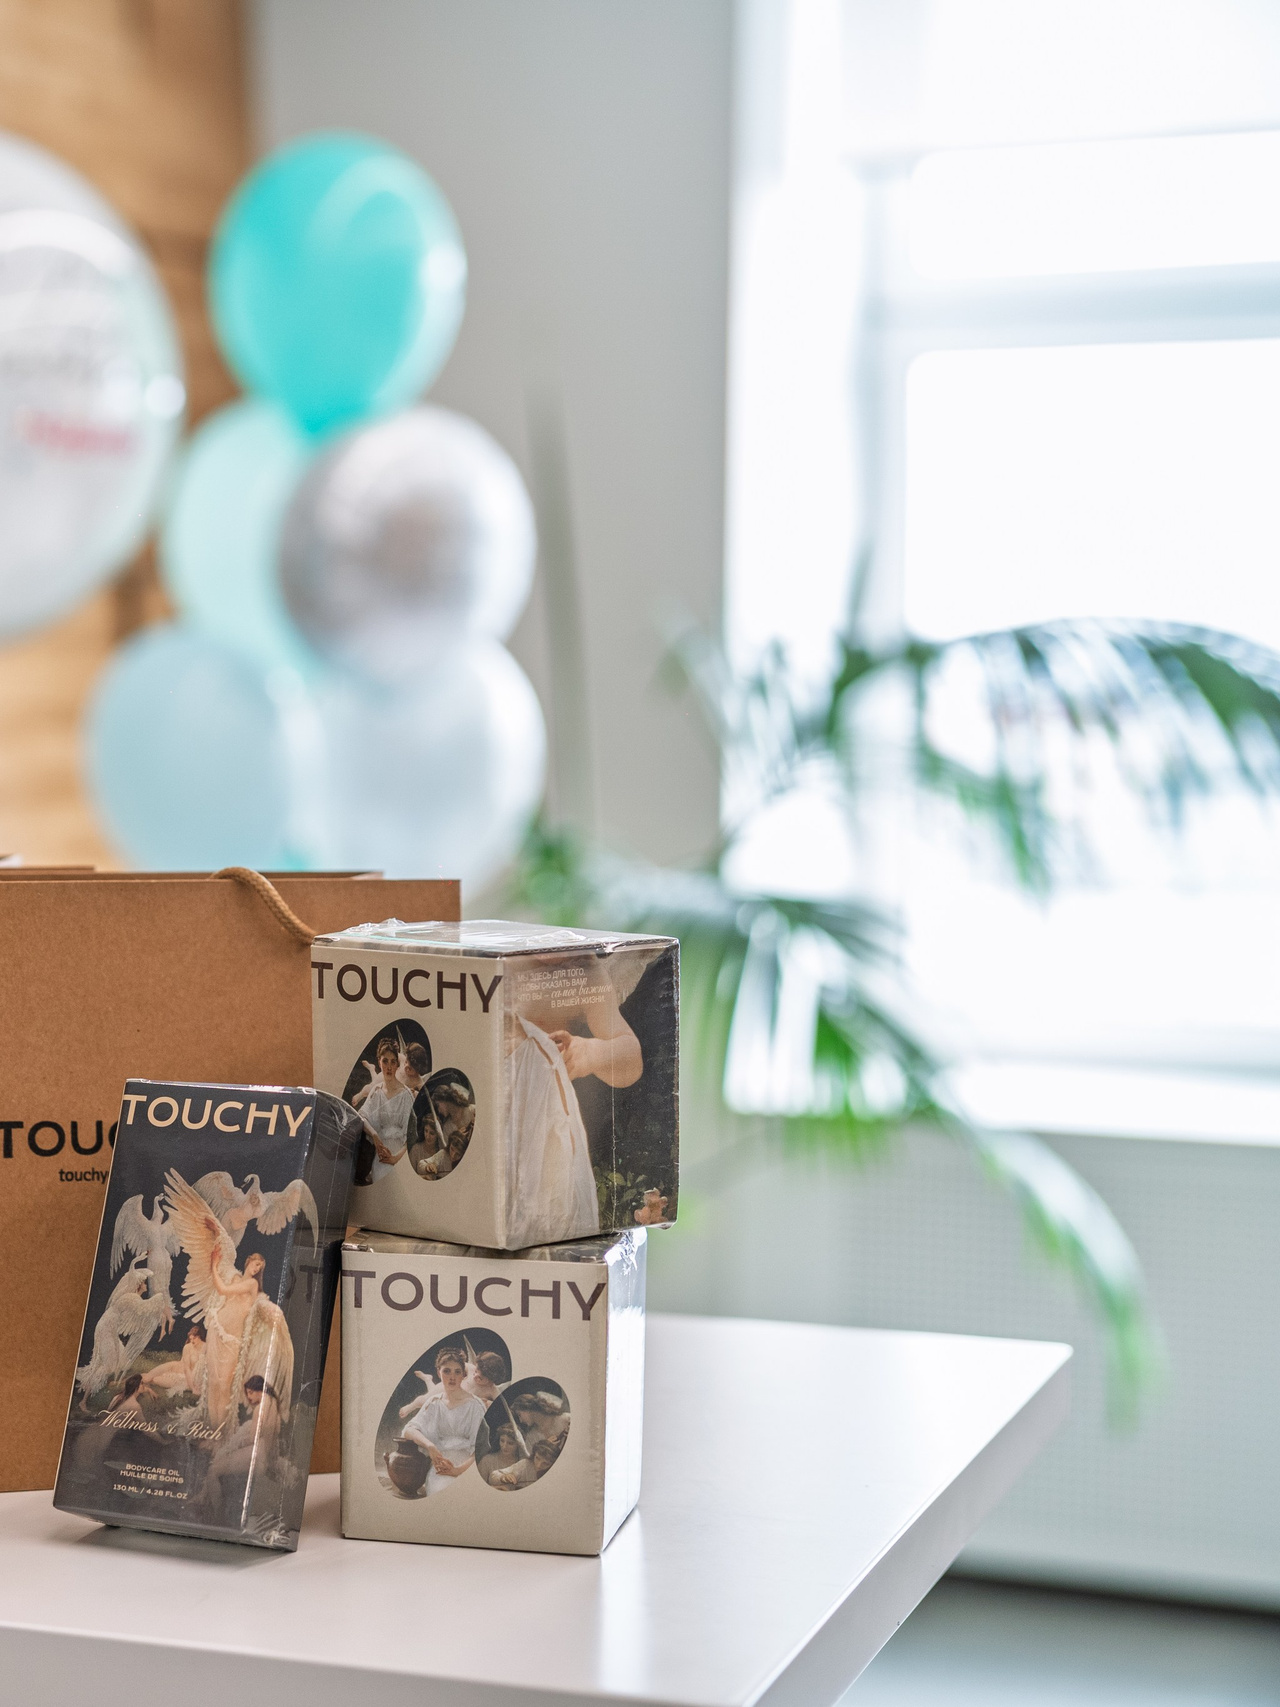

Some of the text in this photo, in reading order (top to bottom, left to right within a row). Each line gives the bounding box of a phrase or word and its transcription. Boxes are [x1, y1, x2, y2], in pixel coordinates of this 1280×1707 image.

[530, 971, 552, 982] ЗДЕСЬ
[552, 969, 566, 979] ДЛЯ
[311, 960, 505, 1013] TOUCHY
[517, 982, 540, 992] ЧТОБЫ
[541, 979, 571, 990] СКАЗАТЬ
[517, 993, 531, 1002] ЧТО
[532, 992, 543, 1000] ВЫ
[551, 1000, 556, 1008] В
[556, 996, 580, 1007] ВАШЕЙ
[122, 1094, 313, 1137] TOUCHY
[341, 1270, 607, 1321] TOUCHY
[98, 1409, 226, 1441] Wellness & Rich
[119, 1469, 146, 1479] HUILLE
[159, 1475, 184, 1484] SOINS
[125, 1463, 180, 1477] BODYCARE OIL
[113, 1483, 127, 1491] 130
[127, 1485, 139, 1493] ML
[146, 1488, 164, 1497] 4.28
